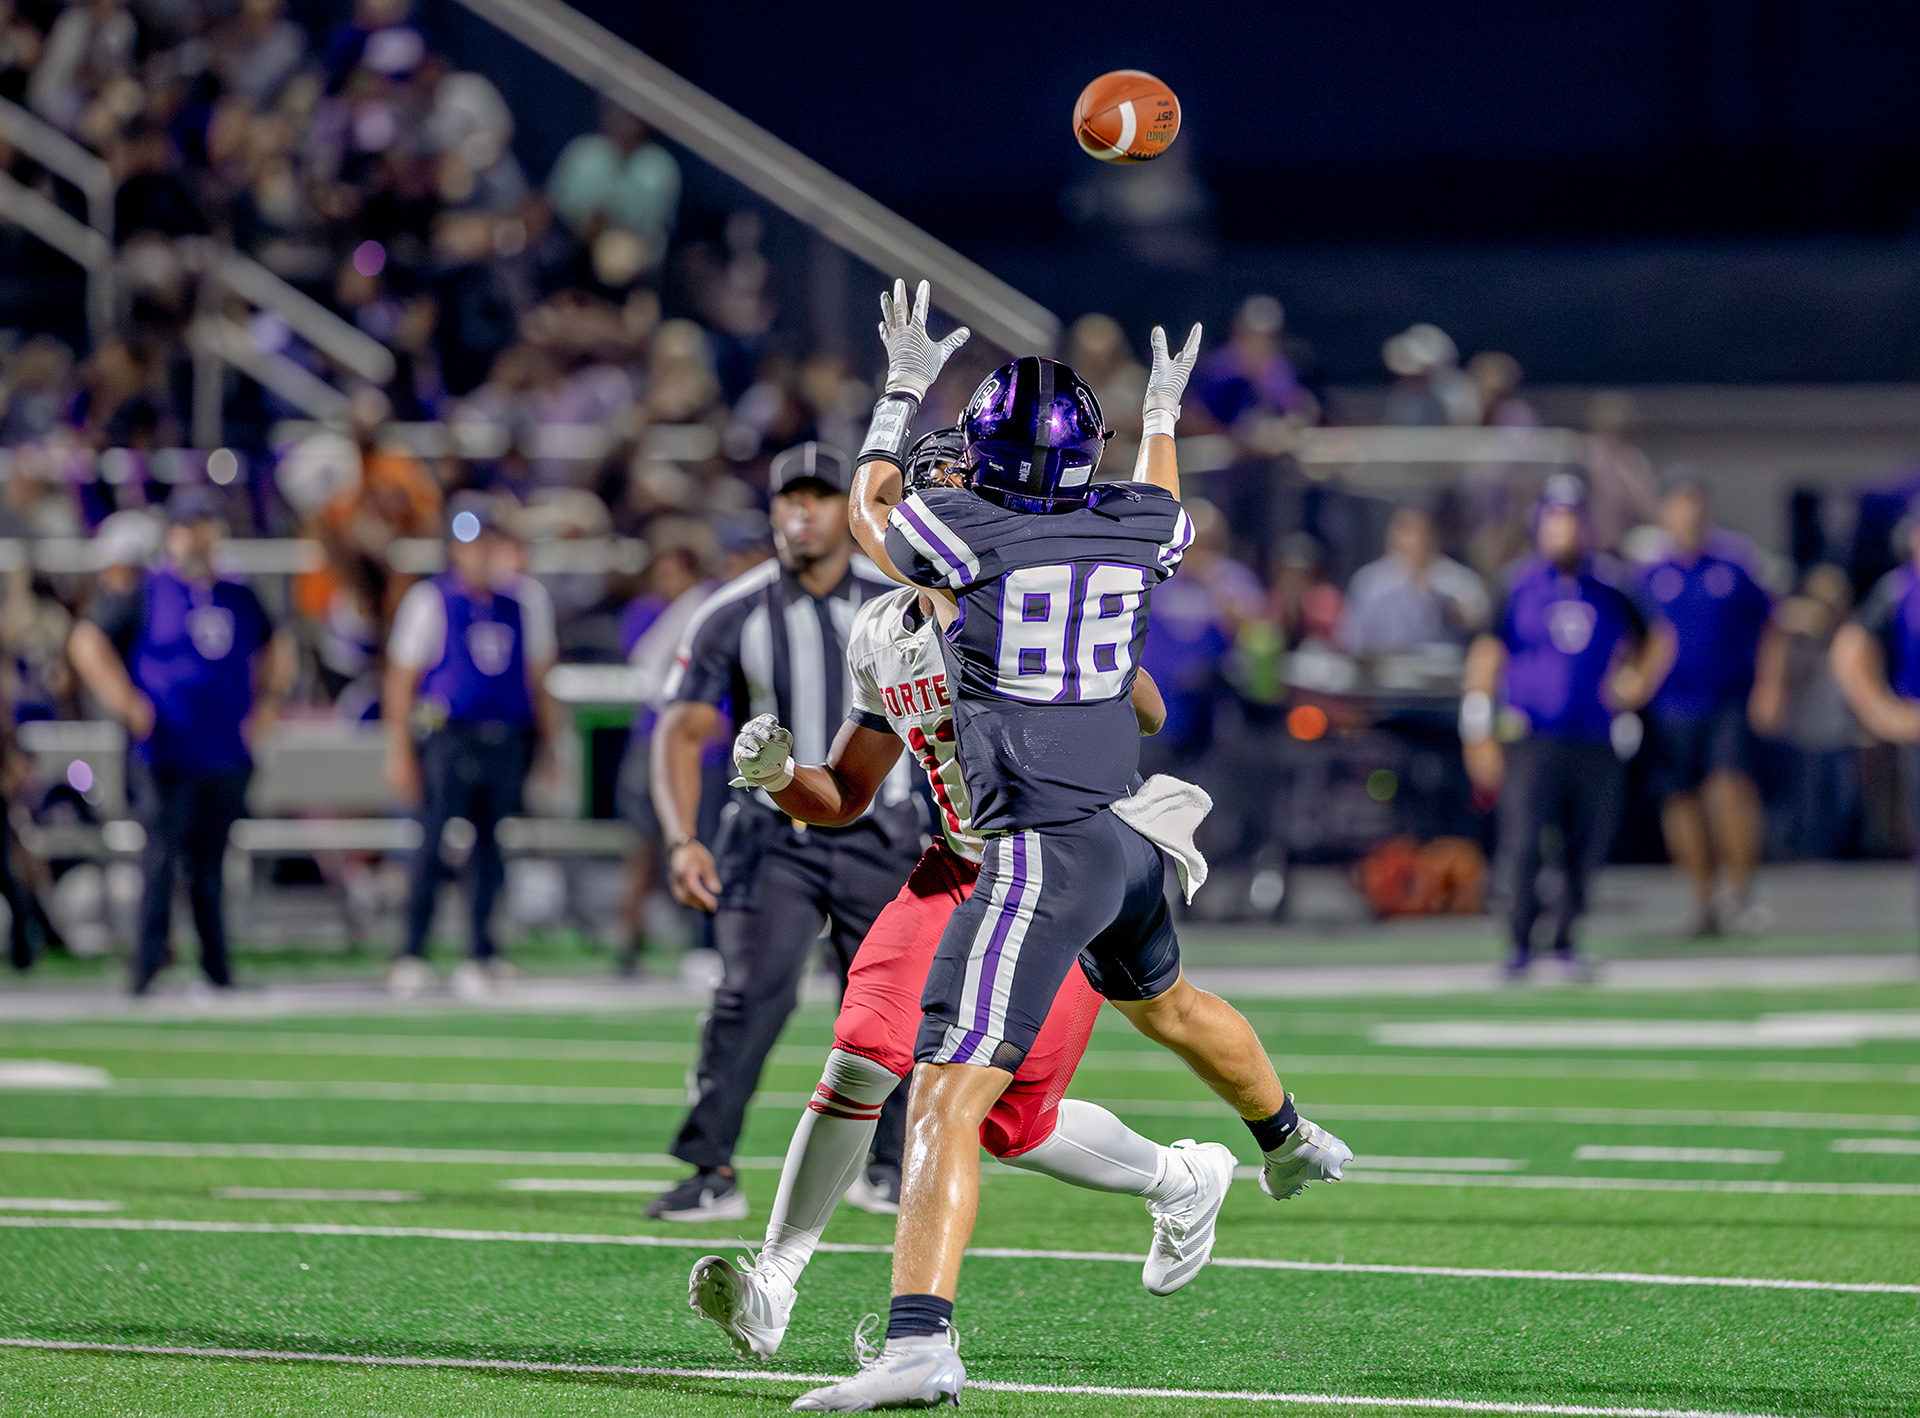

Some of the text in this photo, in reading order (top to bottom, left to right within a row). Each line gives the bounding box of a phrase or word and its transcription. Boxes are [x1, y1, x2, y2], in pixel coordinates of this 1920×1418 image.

[1154, 110, 1174, 122] GST
[1003, 493, 1055, 514] FAMILY
[991, 562, 1147, 702] 88
[880, 673, 951, 720] ORTE
